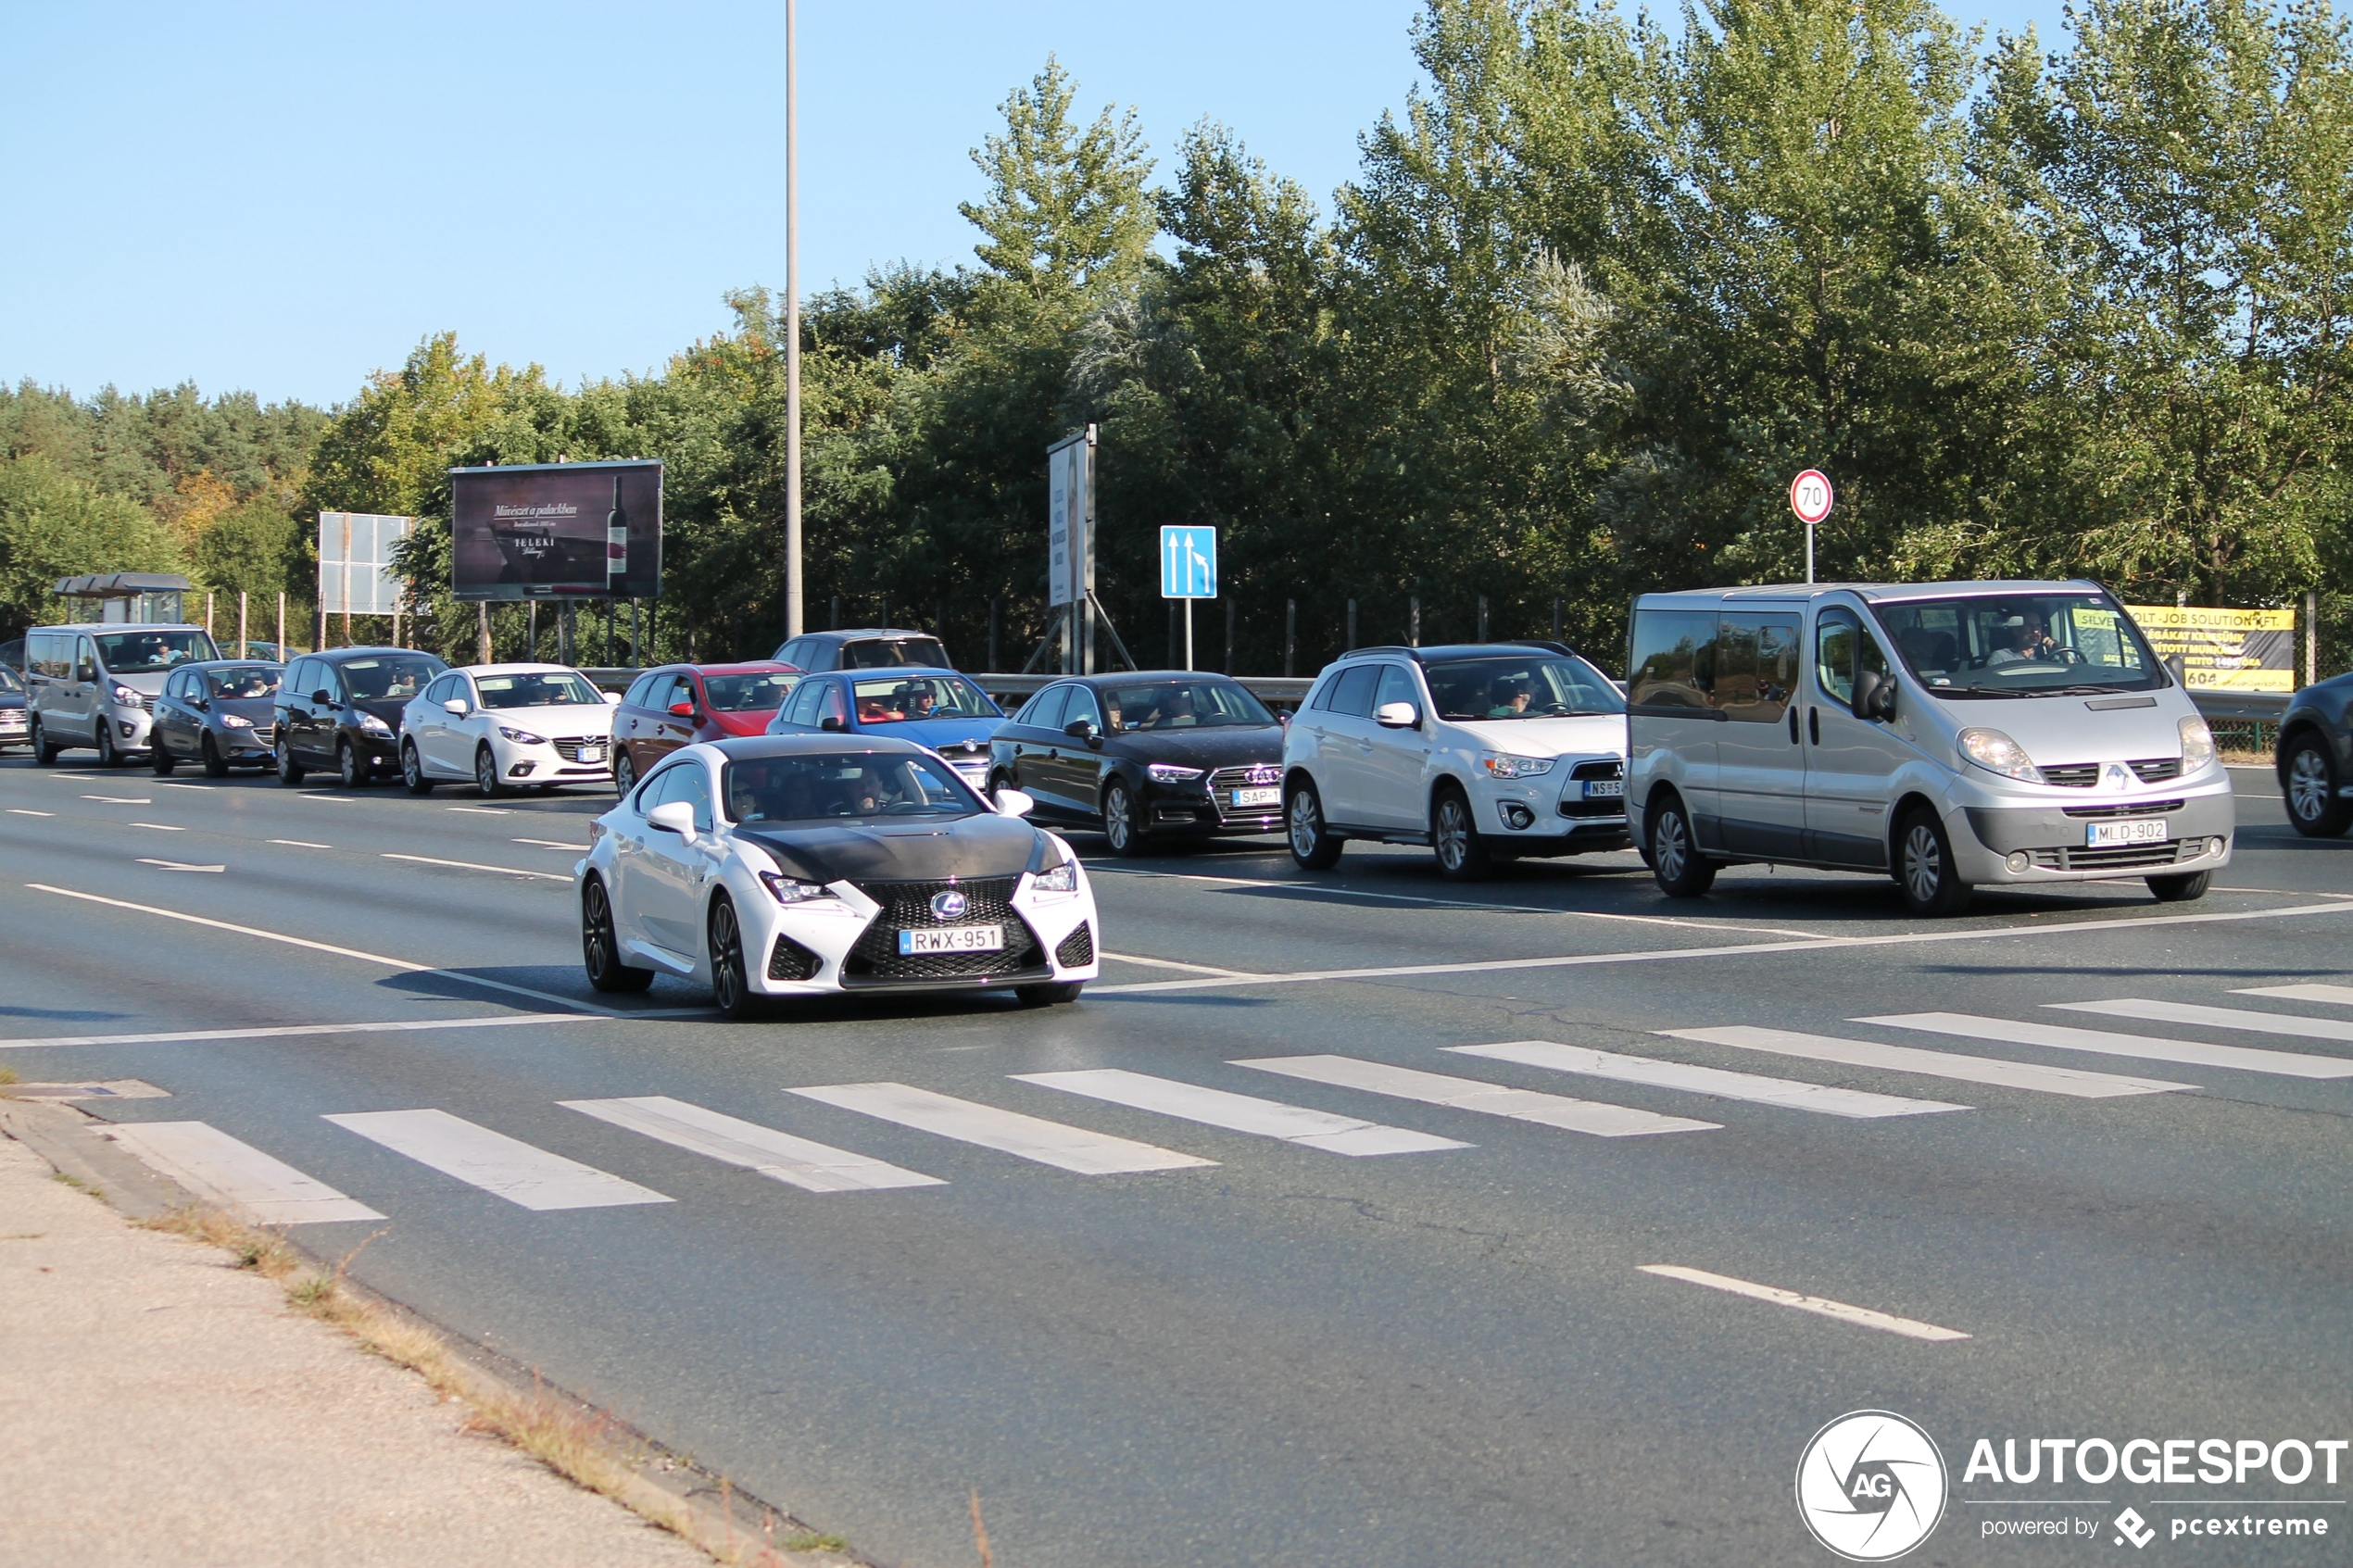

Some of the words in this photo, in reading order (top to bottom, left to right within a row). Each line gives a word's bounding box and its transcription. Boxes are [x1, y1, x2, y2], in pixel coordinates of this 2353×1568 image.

[1803, 487, 1821, 506] 70
[529, 508, 535, 516] a
[535, 503, 577, 519] palackban
[514, 537, 555, 547] TELEKI
[2191, 614, 2251, 627] SOLUTION
[1592, 783, 1605, 795] NS
[1242, 791, 1278, 803] SAP-1
[2098, 822, 2163, 841] MLD-902
[915, 930, 996, 950] RWX-951
